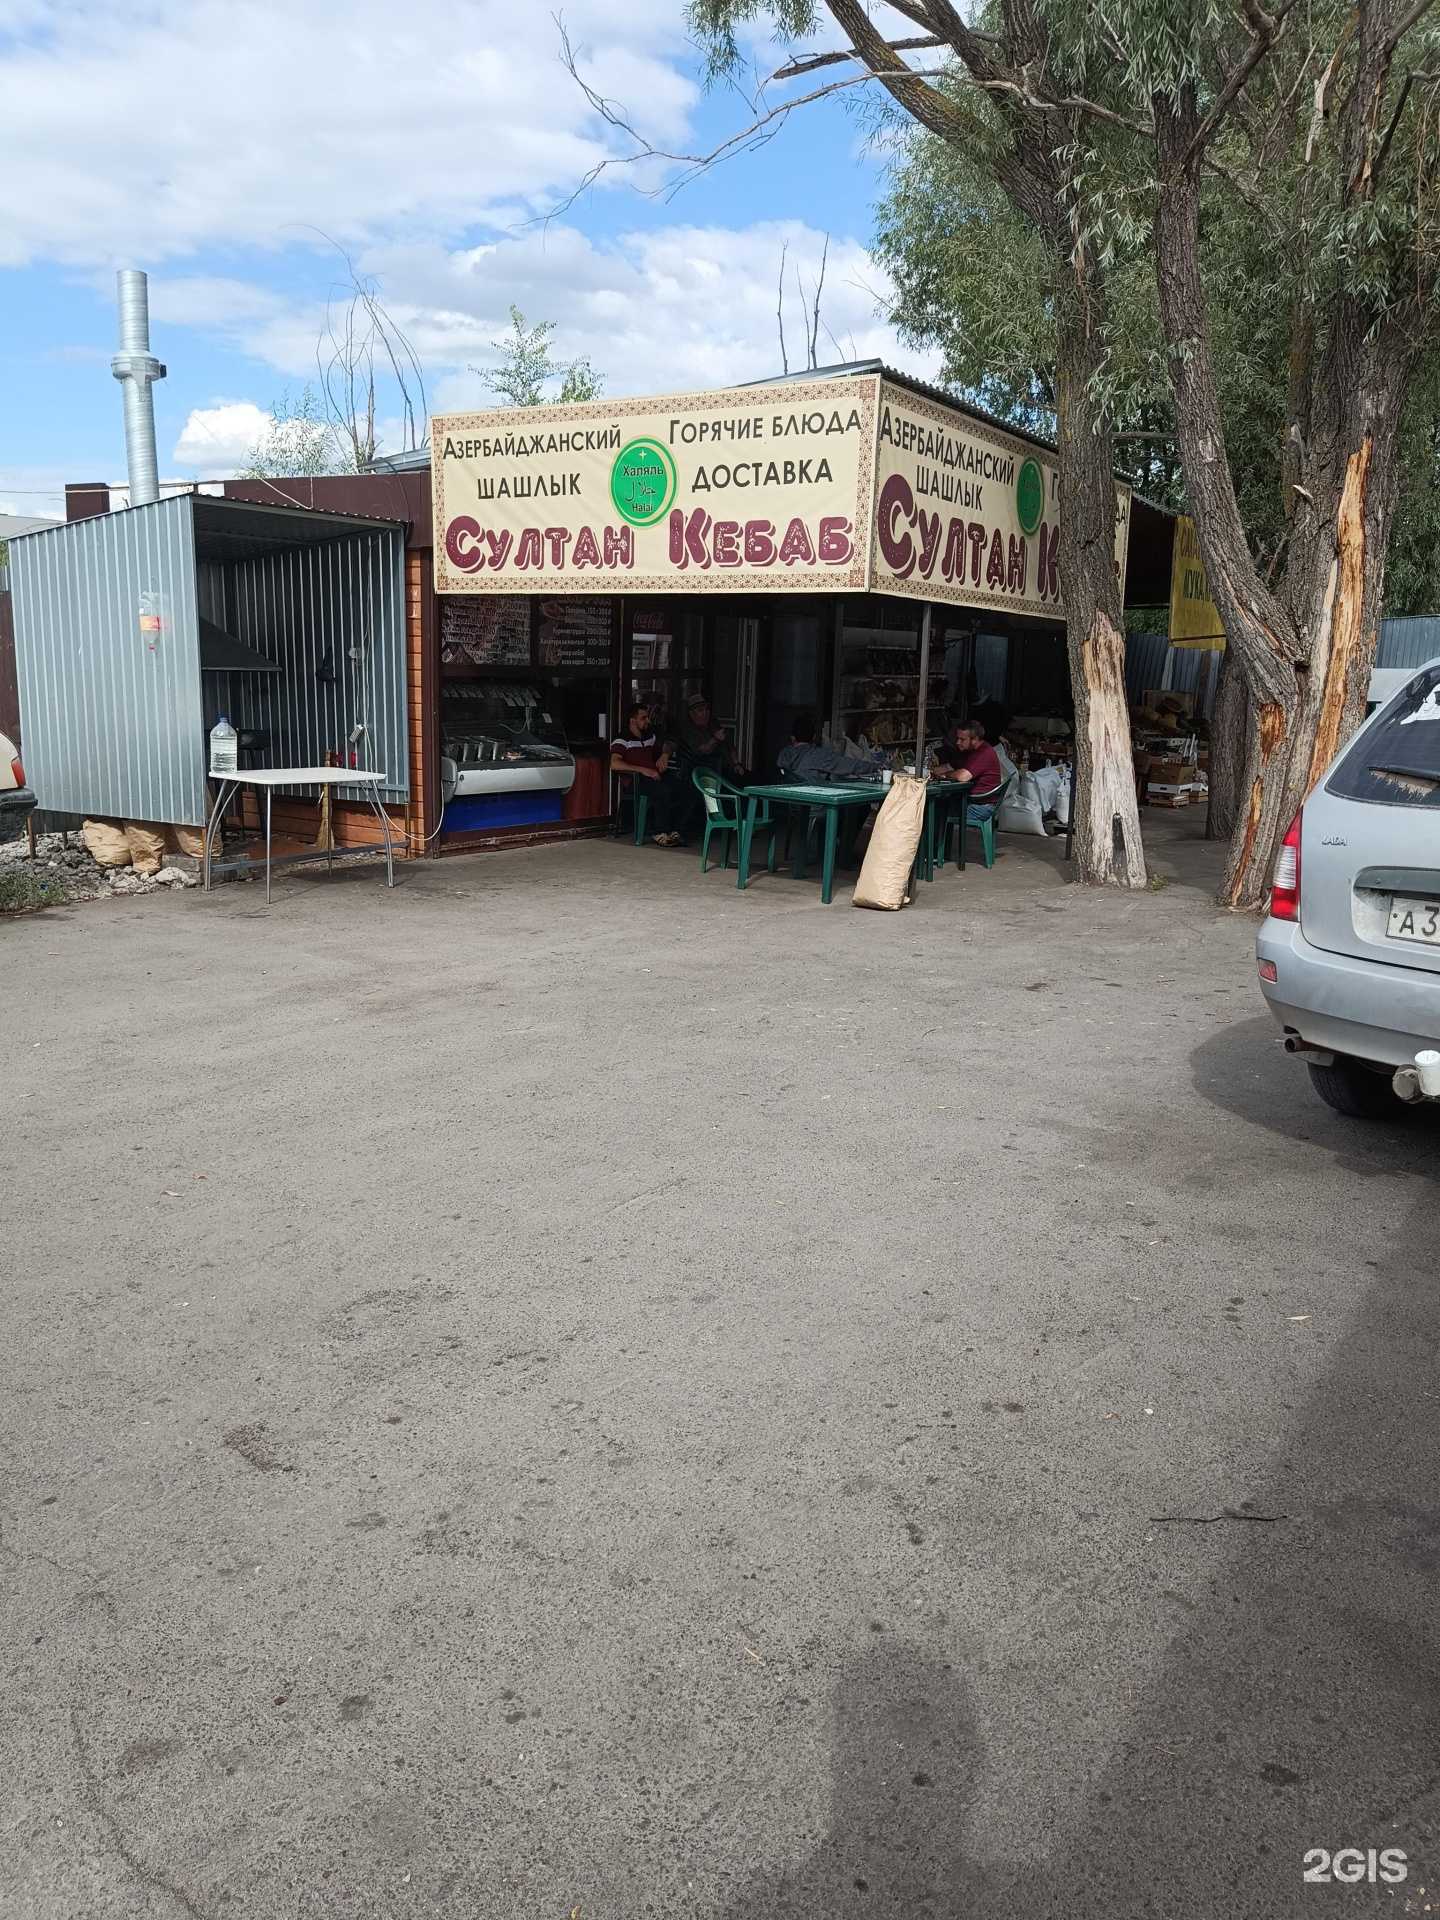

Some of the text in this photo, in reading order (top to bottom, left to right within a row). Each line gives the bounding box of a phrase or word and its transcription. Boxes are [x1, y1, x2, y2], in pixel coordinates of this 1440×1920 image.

[443, 424, 621, 459] АЗЕРБАЙДЖАНСКИЙ
[669, 409, 862, 444] ГОРЯЧИЕ БЛЮДА
[880, 406, 1015, 487] АЗЕРБАЙДЖАНСКИЙ
[477, 473, 582, 500] ШАШЛЫК
[623, 465, 664, 477] Халяль
[691, 458, 833, 493] ДОСТАВКА
[916, 465, 983, 511] ШАШЛЫК
[445, 507, 855, 574] СУЛТАН КЕБАБ
[878, 474, 1027, 596] СУЛТАН
